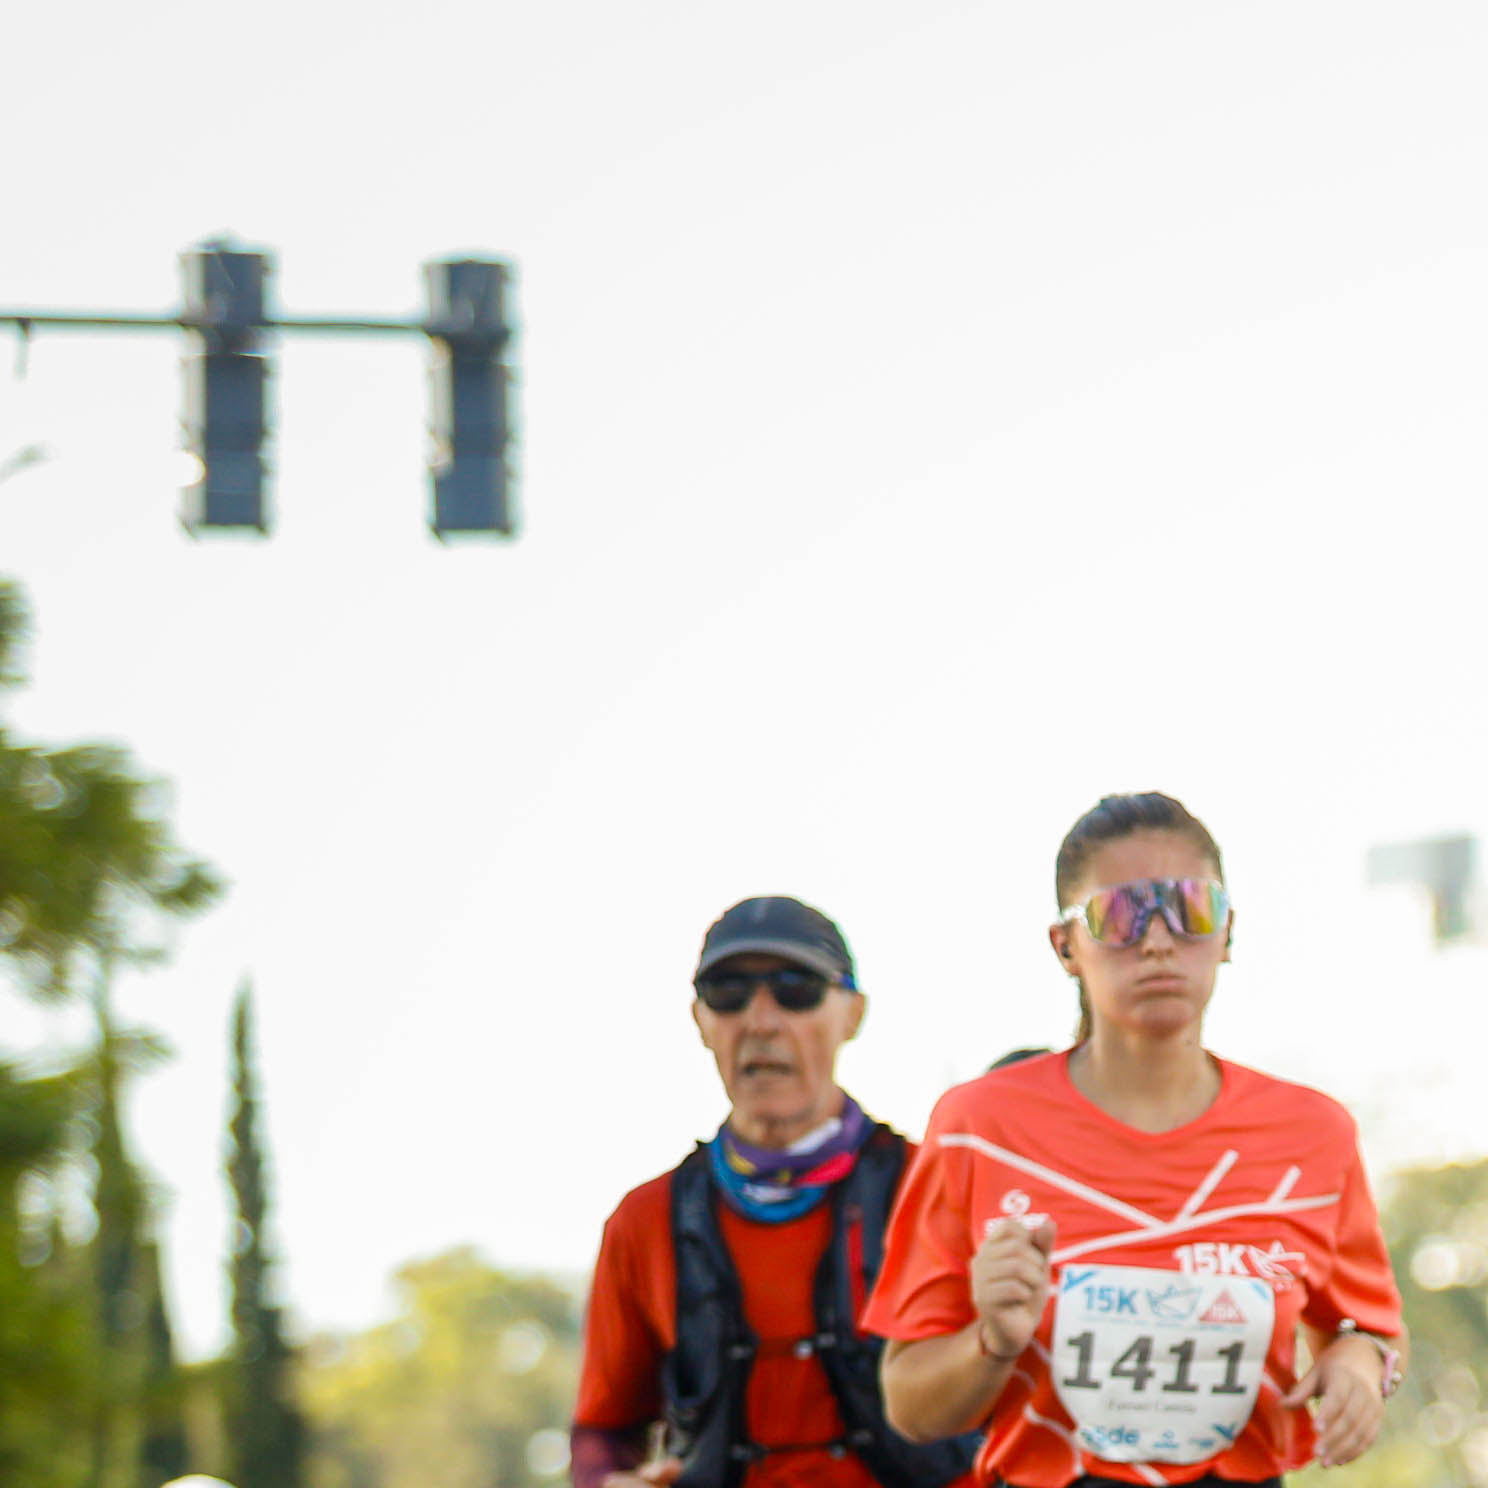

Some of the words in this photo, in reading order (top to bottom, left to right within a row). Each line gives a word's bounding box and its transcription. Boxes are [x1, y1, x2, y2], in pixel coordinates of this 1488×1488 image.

[1172, 1241, 1250, 1275] 15K
[1083, 1285, 1138, 1315] 15K
[1062, 1330, 1247, 1394] 1411
